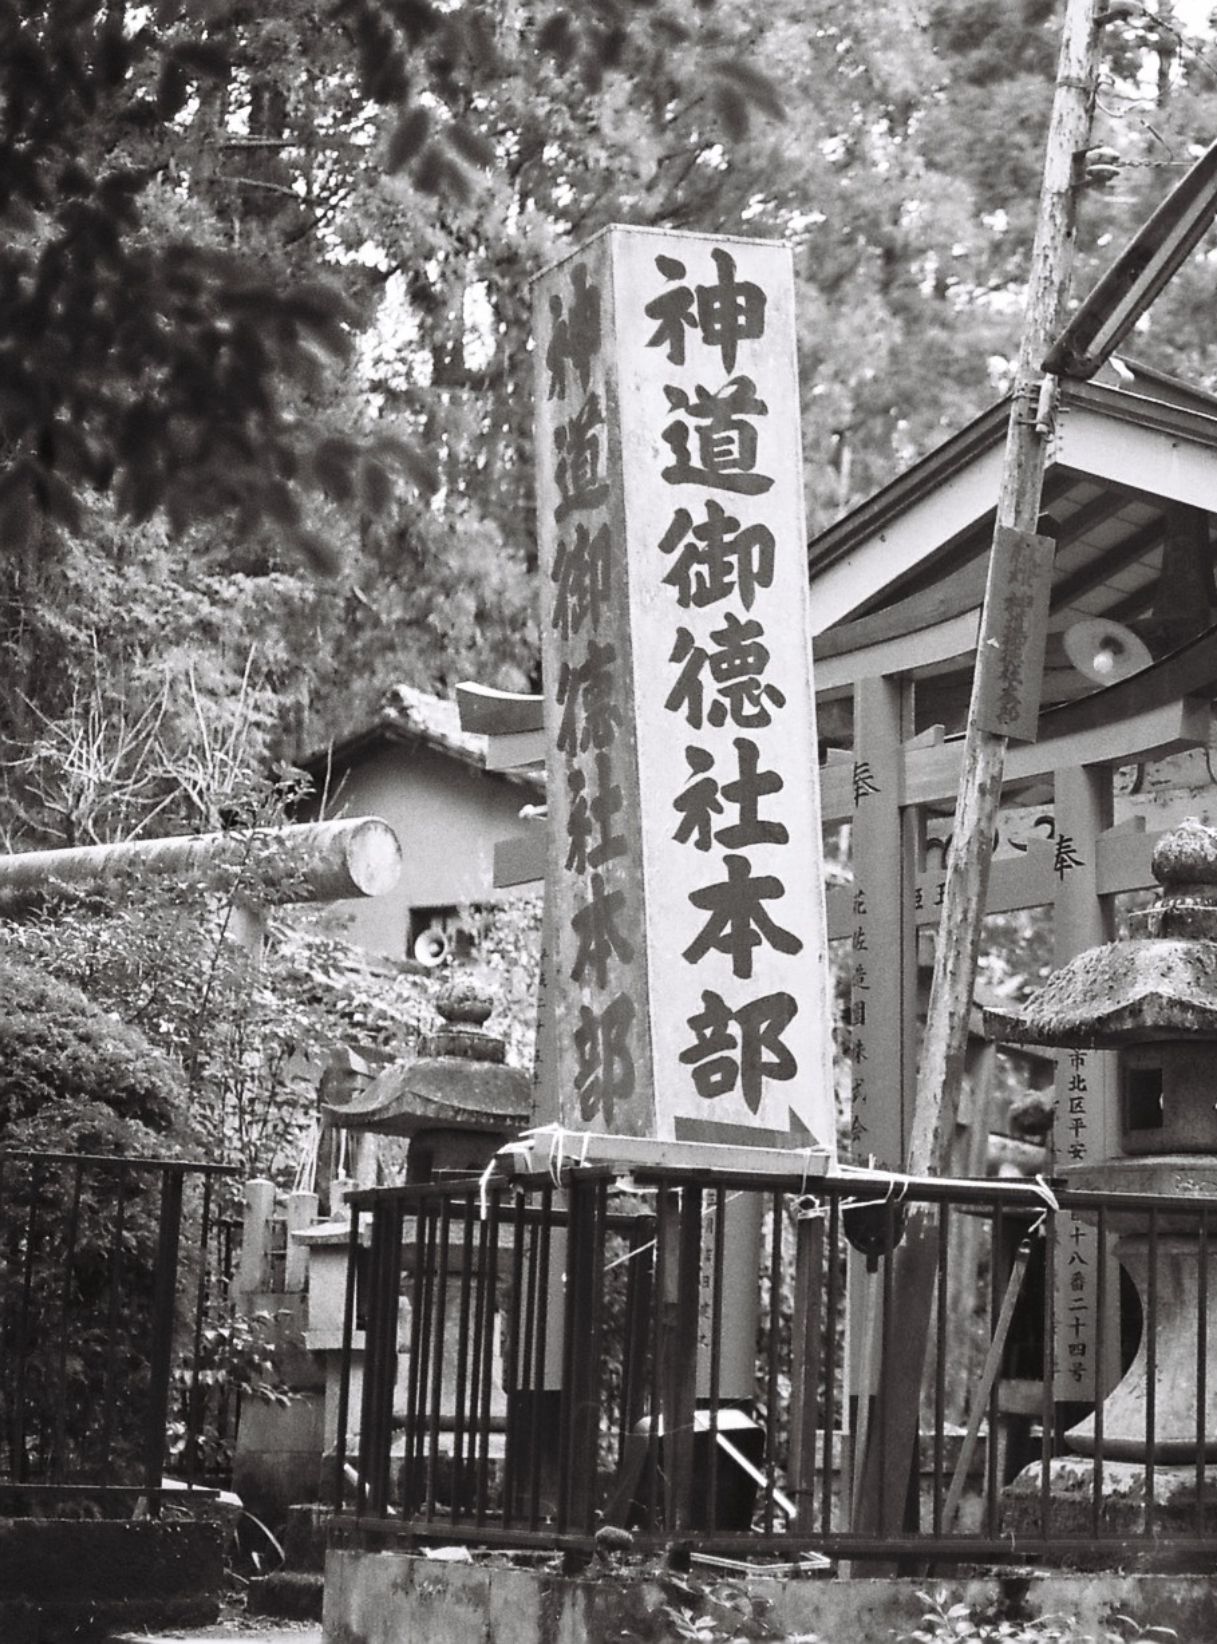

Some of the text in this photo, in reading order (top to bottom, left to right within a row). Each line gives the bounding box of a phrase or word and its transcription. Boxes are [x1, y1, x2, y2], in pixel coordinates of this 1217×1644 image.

[1053, 833, 1085, 881] 奉
[1069, 1049, 1088, 1160] 市北区平安
